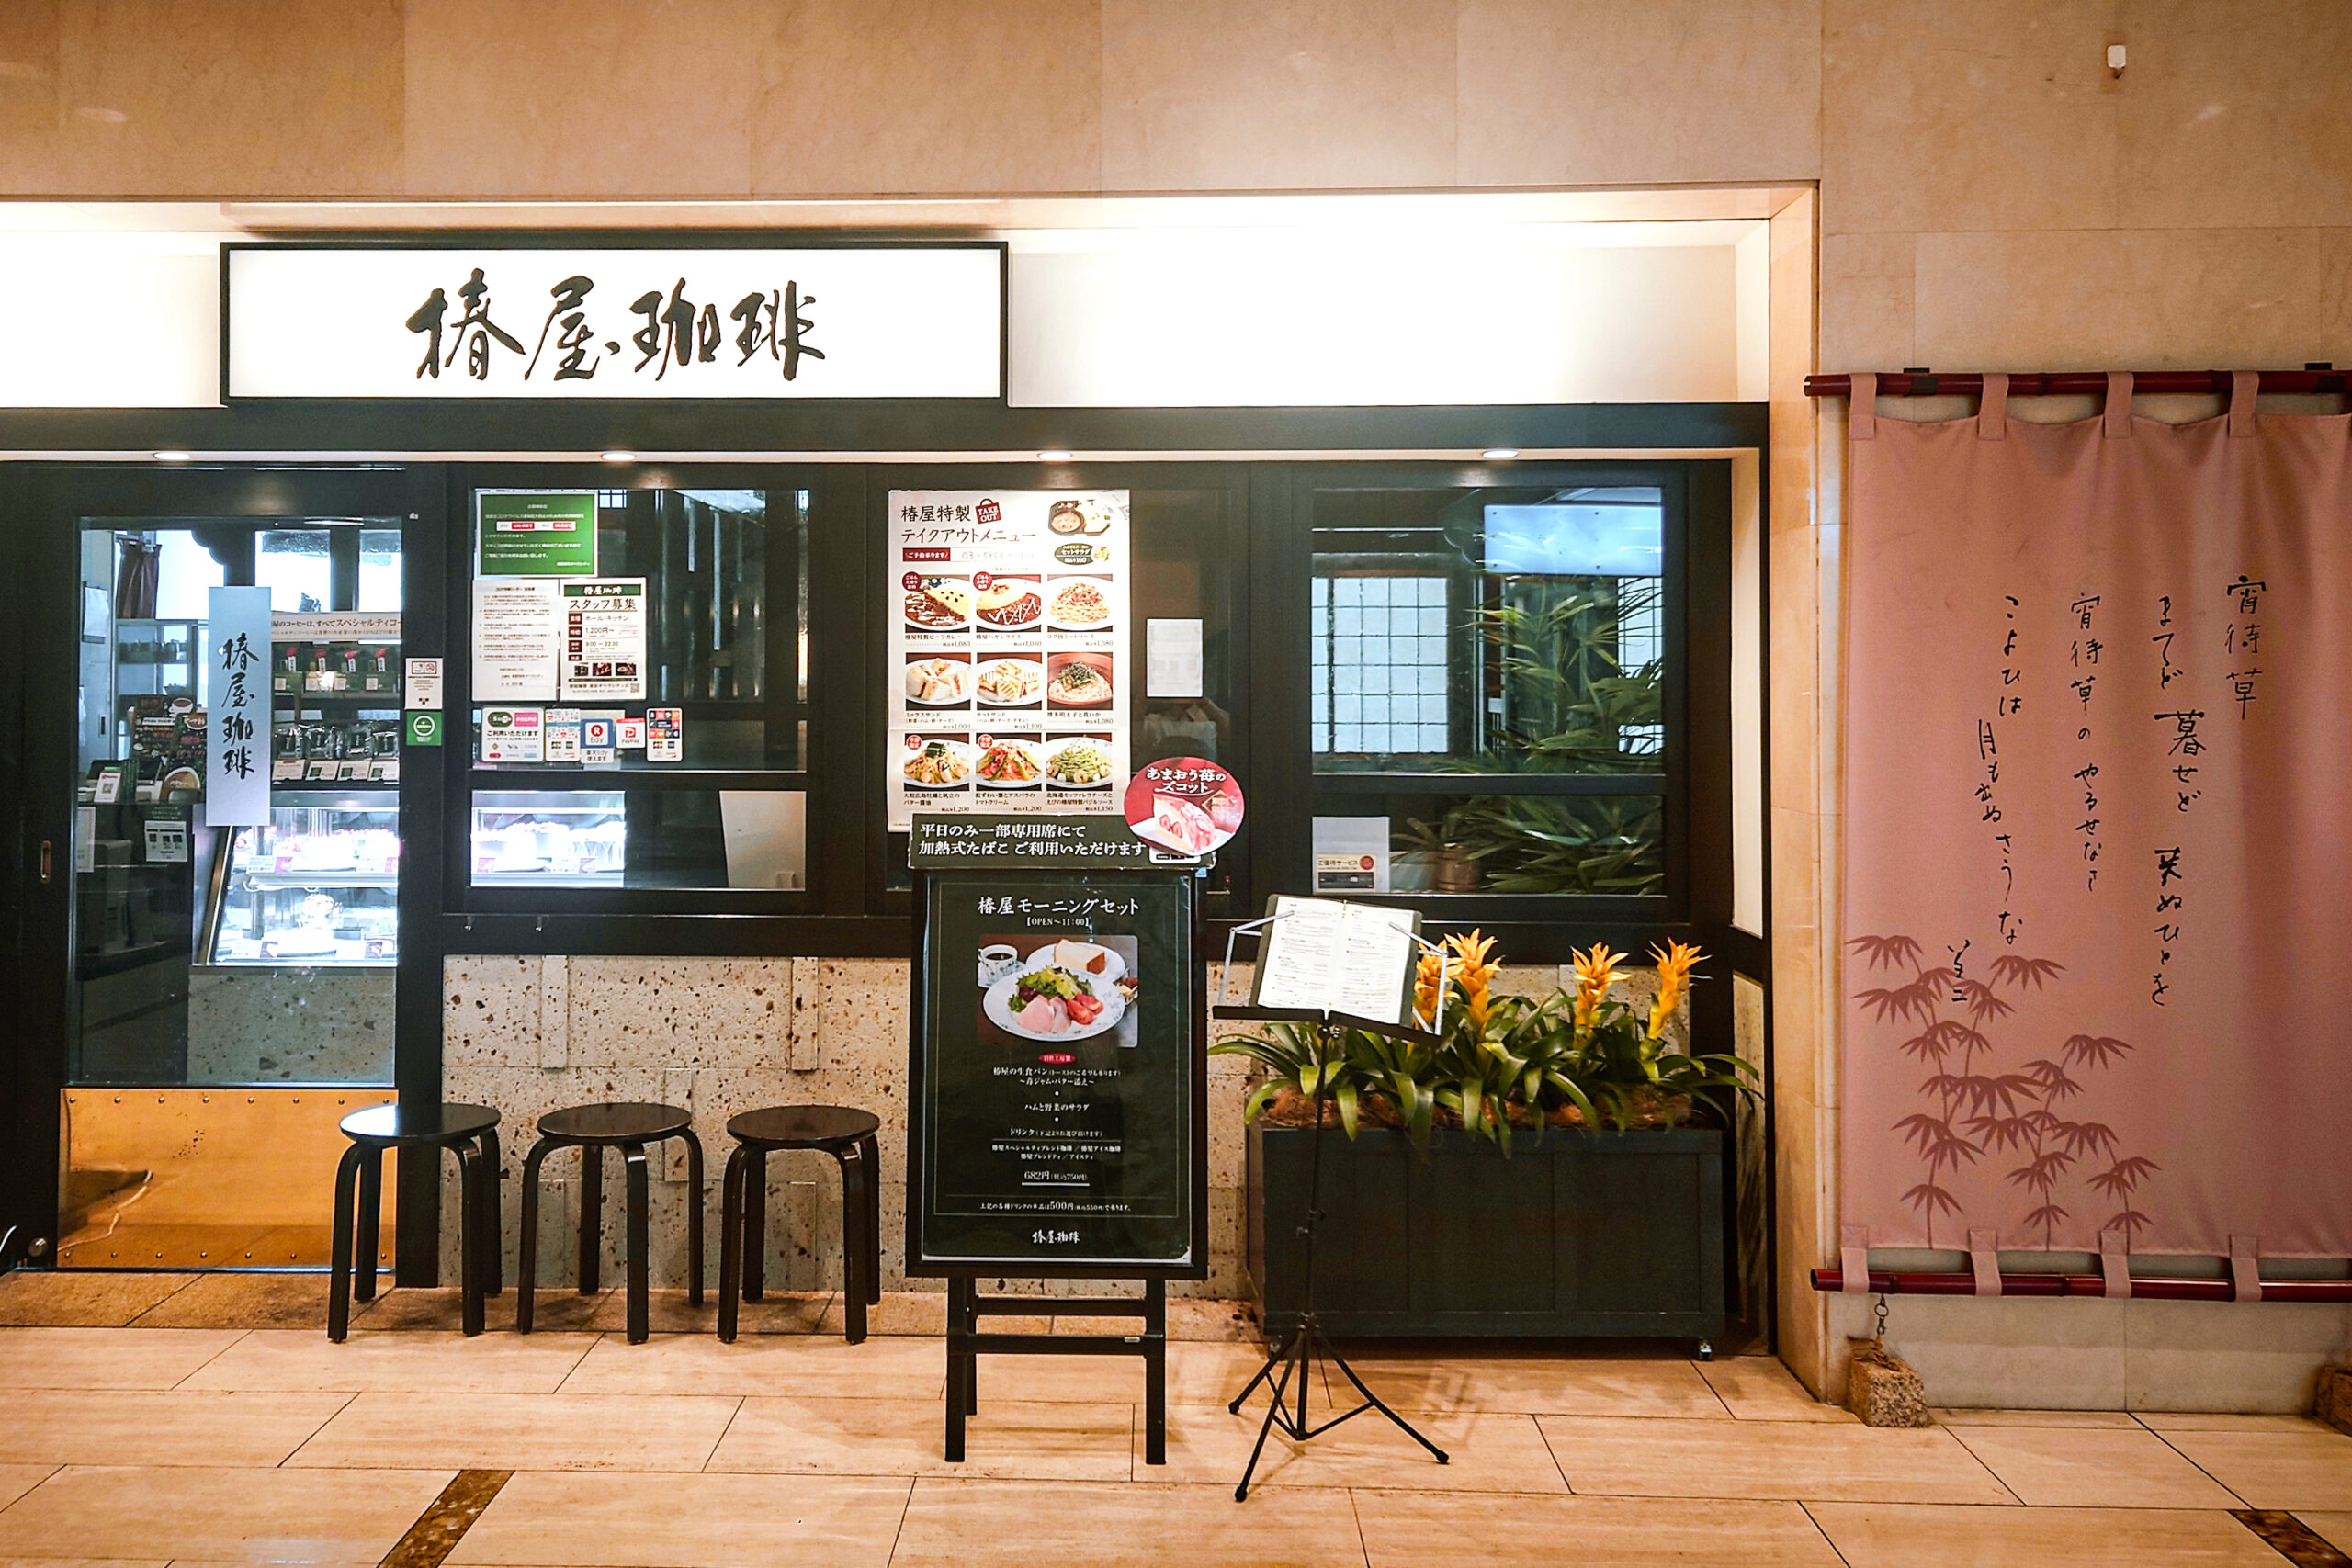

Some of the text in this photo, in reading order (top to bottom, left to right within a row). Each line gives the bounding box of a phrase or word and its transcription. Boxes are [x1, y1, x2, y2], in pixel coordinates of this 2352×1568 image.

[406, 267, 825, 382] 椿屋珈琲
[901, 504, 971, 523] 椿屋特製
[977, 506, 999, 515] TAKE
[980, 513, 998, 523] OUT
[901, 528, 1036, 543] テイクアウトメニュー
[570, 598, 636, 610] スタッフ募集
[2224, 575, 2267, 720] 宵待草
[221, 632, 260, 780] 椿屋珈琲
[1146, 766, 1227, 782] あまおう苺の
[1161, 781, 1209, 793] ズコット
[919, 823, 1086, 839] 平日のみ一部専用席にて
[918, 840, 1010, 856] 加熱式たばこ
[1013, 841, 1147, 857] ご利用いただけます
[977, 896, 1139, 917] 椿屋モーニングセット
[1024, 1103, 1090, 1111] ハムと野菜のサラダ
